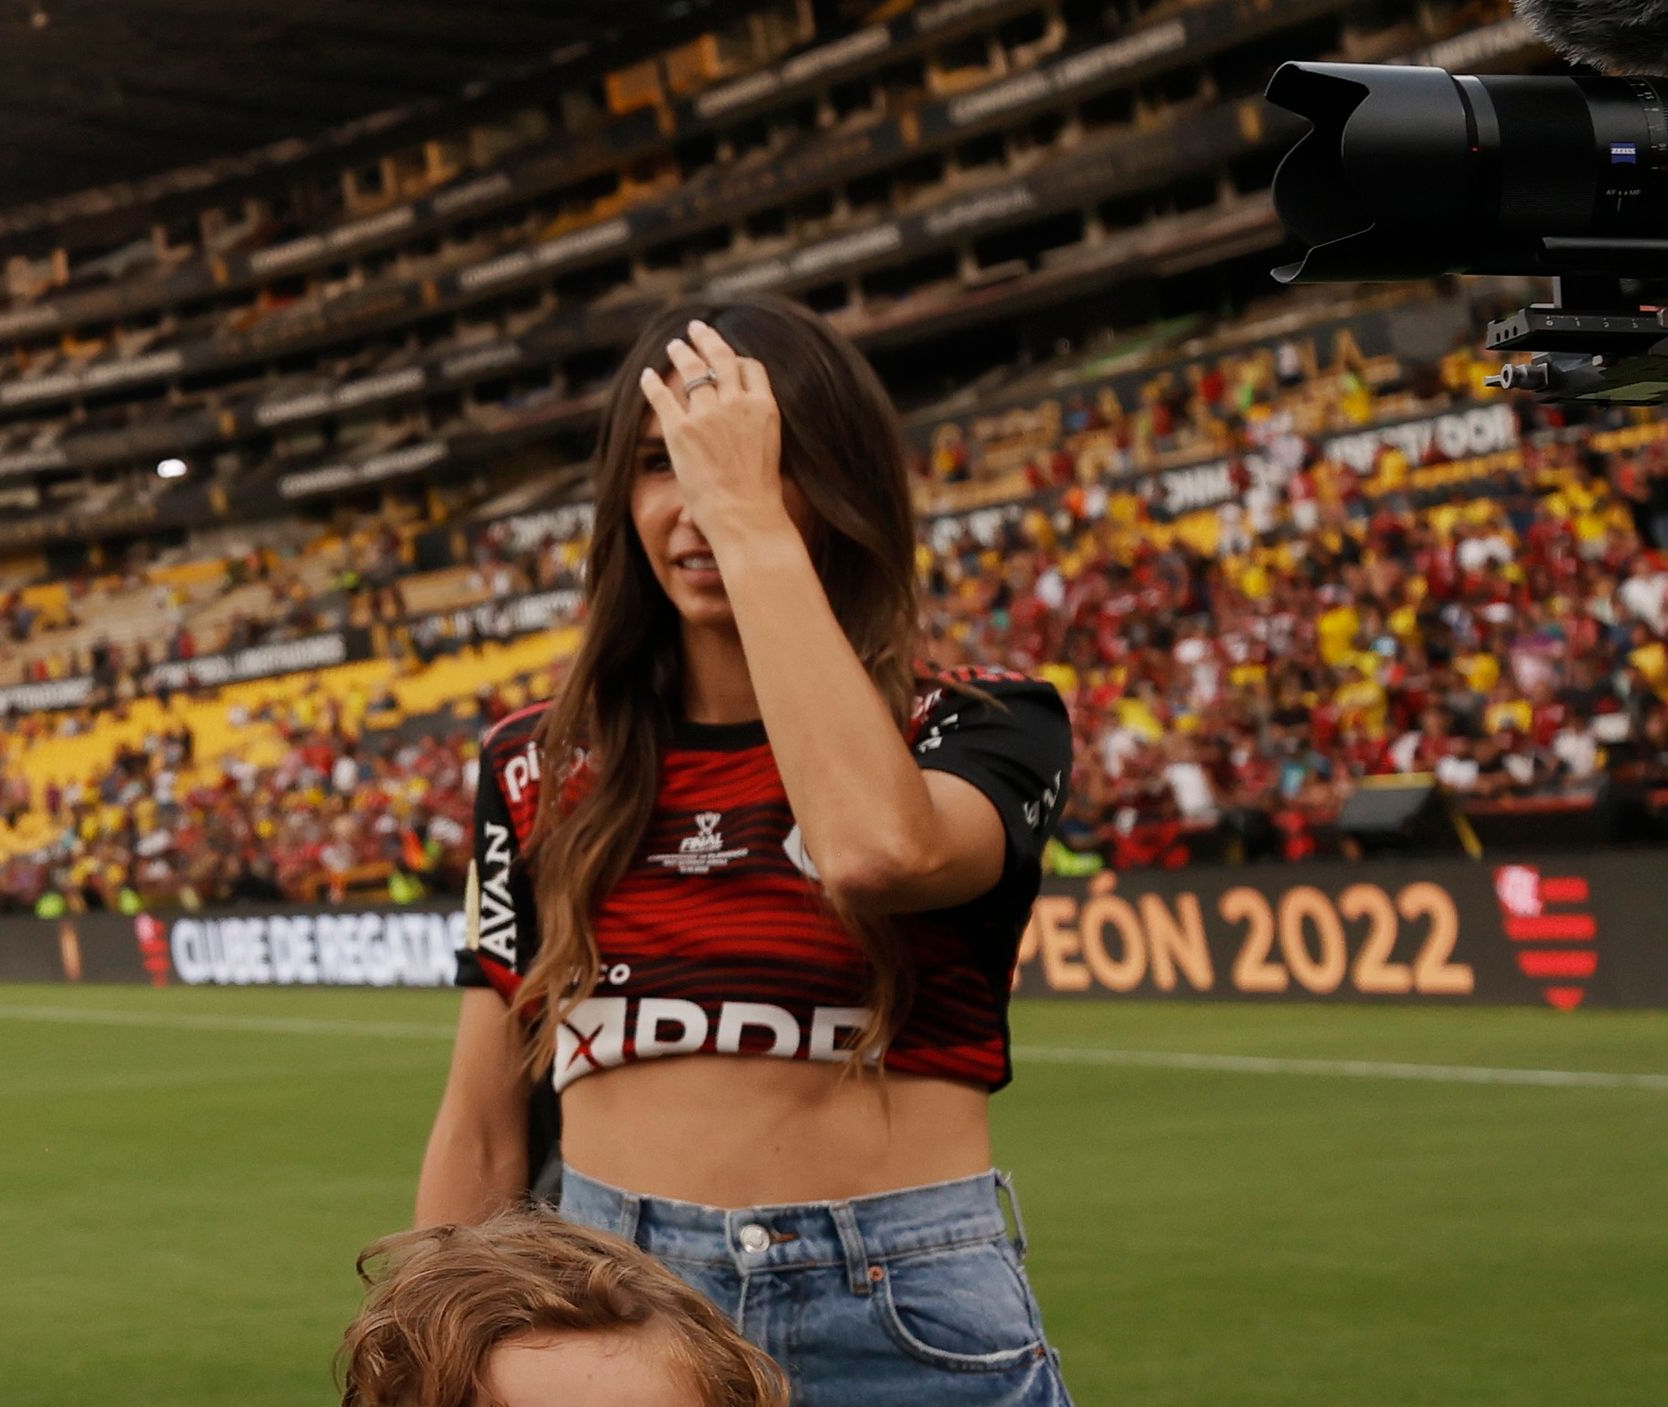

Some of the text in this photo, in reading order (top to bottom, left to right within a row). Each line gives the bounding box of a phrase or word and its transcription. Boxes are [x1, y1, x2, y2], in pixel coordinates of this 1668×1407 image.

[171, 916, 266, 986] CLUBE
[266, 913, 316, 985] DE
[478, 821, 519, 974] AVAN
[1217, 881, 1475, 994] 2022
